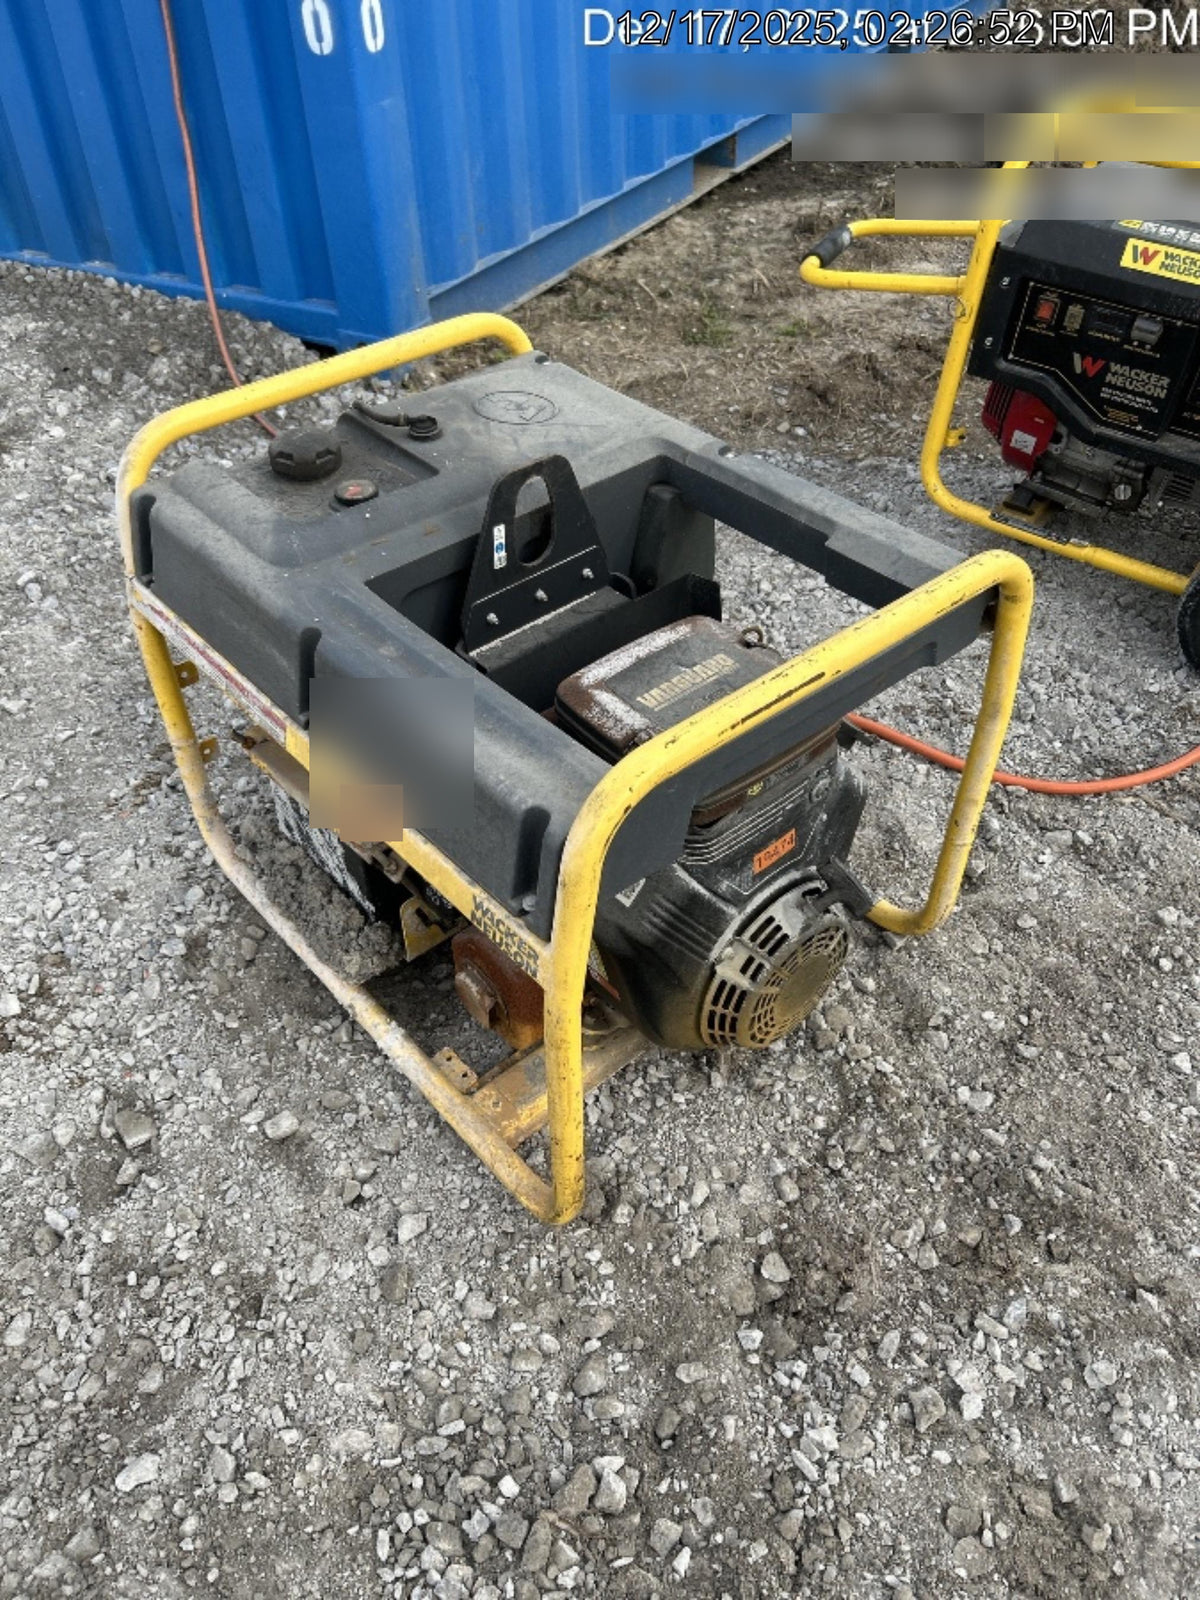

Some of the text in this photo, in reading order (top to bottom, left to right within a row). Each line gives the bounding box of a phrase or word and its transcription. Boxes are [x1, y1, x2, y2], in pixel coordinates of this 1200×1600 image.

[1105, 374, 1167, 399] NEUSON
[1109, 362, 1171, 388] WACKER
[470, 909, 538, 979] NEUSON
[472, 894, 539, 967] WACKER
